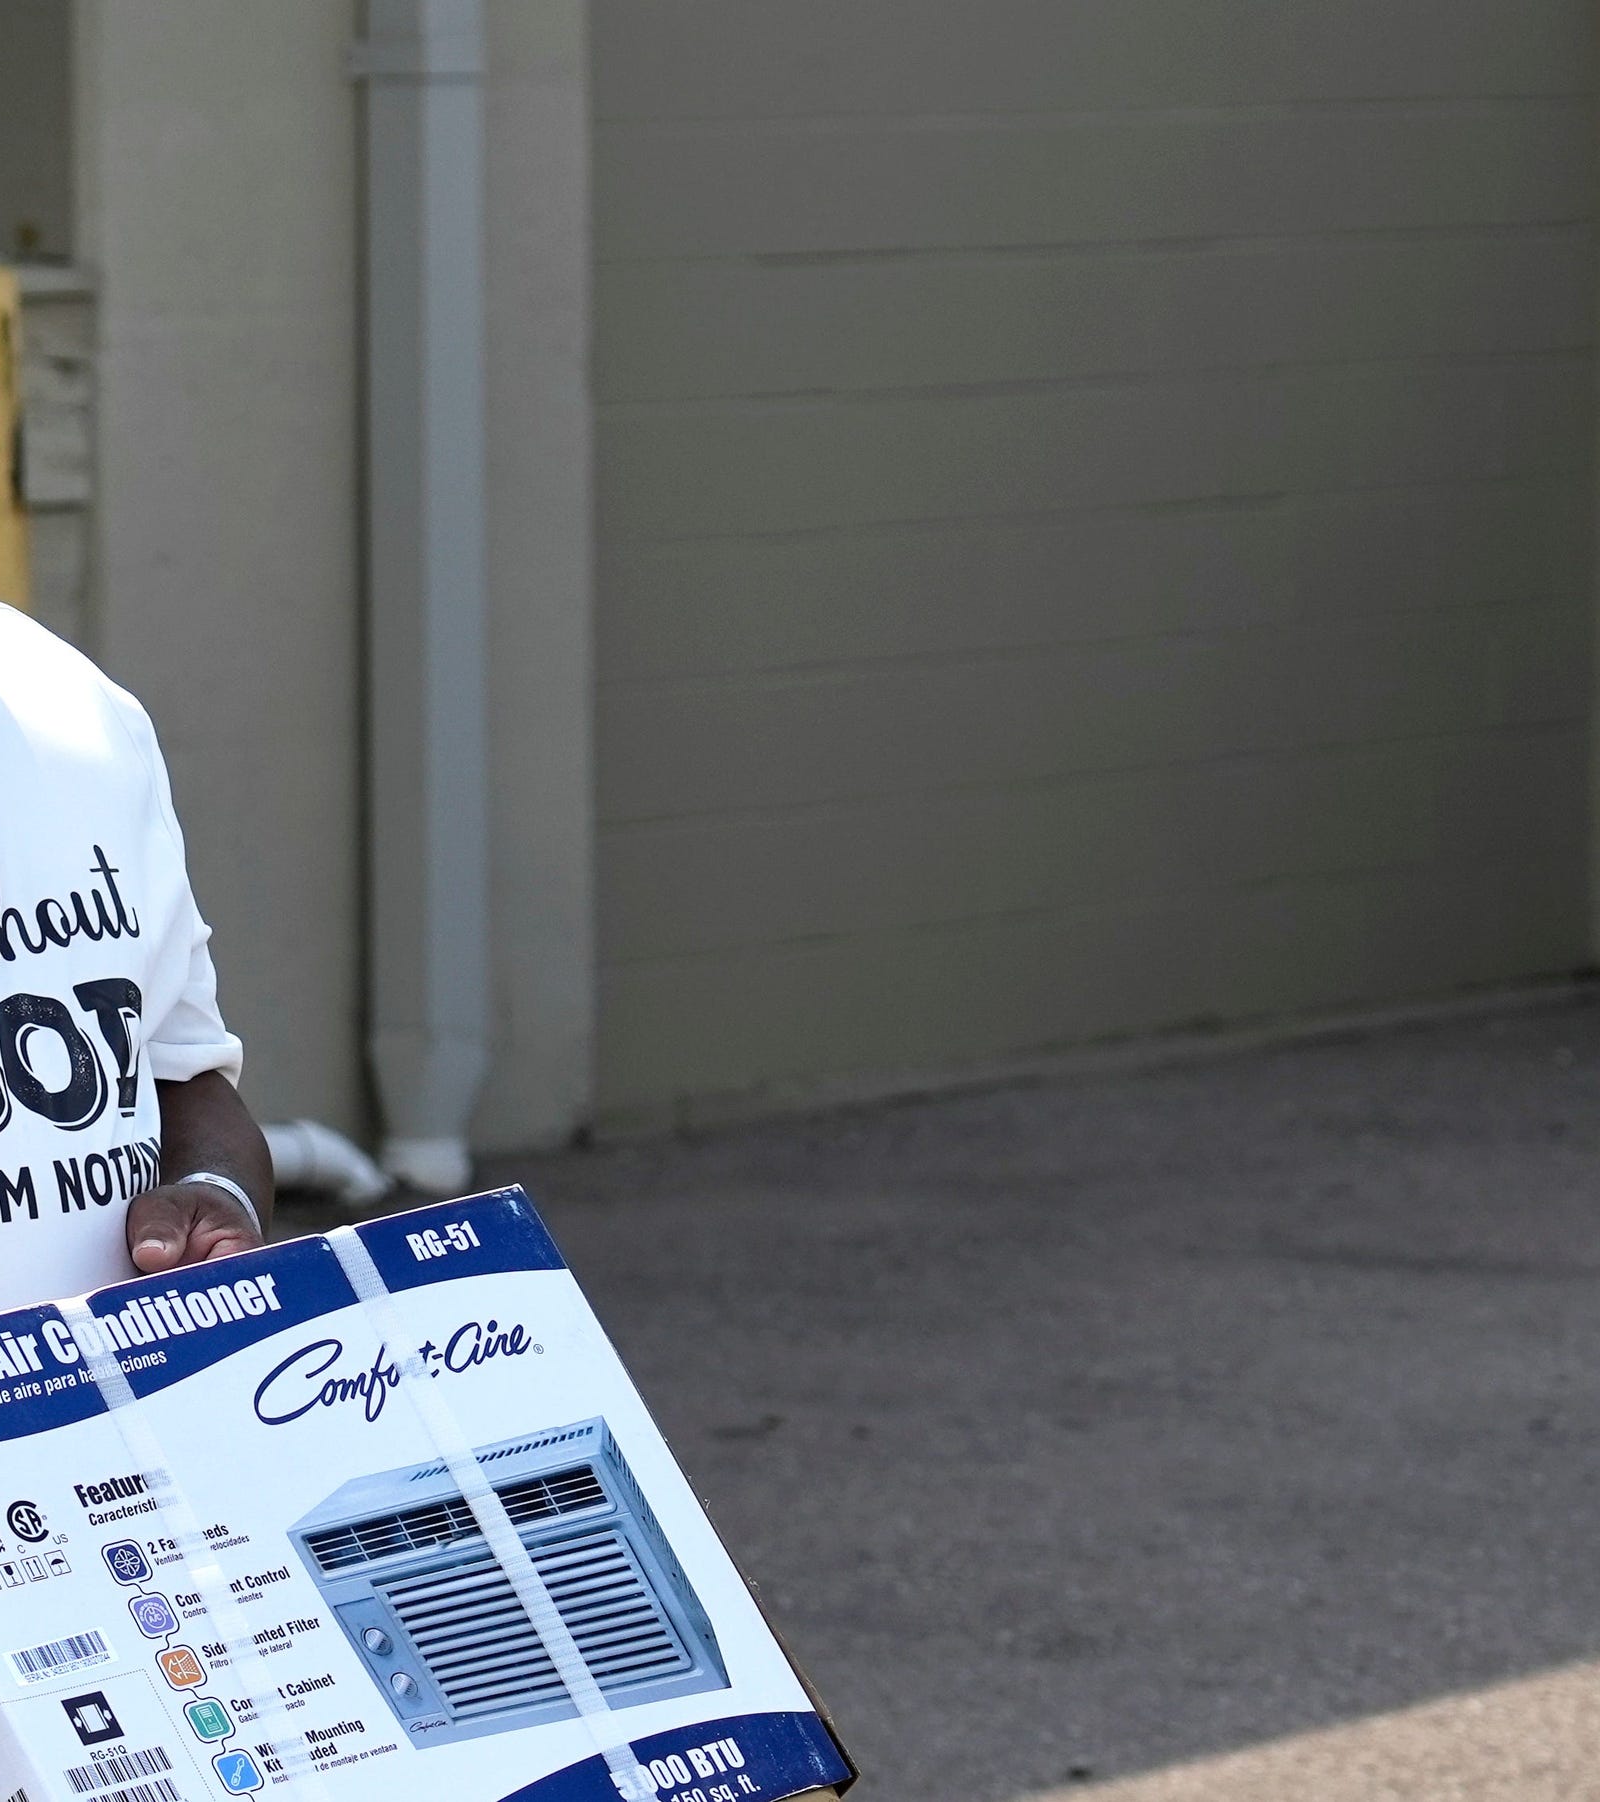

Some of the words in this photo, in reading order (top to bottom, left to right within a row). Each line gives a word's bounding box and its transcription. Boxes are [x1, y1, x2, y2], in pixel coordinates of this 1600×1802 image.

[52, 1136, 161, 1213] NOTHIN
[405, 1220, 481, 1261] RG-51
[14, 1380, 42, 1402] aire
[45, 1376, 78, 1400] para
[78, 1350, 167, 1384] haciones
[253, 1319, 532, 1425] Comfot-Aire
[73, 1472, 155, 1508] Featur
[89, 1497, 159, 1526] Característi
[146, 1541, 158, 1555] 2
[157, 1538, 177, 1552] Fa
[245, 1566, 291, 1590] Control
[286, 1617, 321, 1635] Filter
[269, 1639, 293, 1653] lateral
[209, 1658, 229, 1670] Filtro
[286, 1673, 336, 1697] Cabinet
[285, 1699, 306, 1711] pacto
[304, 1719, 366, 1744] Mounting
[89, 1744, 127, 1762] RG-51Q
[263, 1758, 284, 1773] Kit
[320, 1762, 329, 1771] de
[330, 1753, 358, 1768] montaje
[359, 1751, 369, 1760] en
[370, 1743, 398, 1757] ventana
[609, 1754, 692, 1800] 5000
[685, 1737, 746, 1778] BTU
[709, 1783, 739, 1802] sq.
[737, 1774, 761, 1794] ft.
